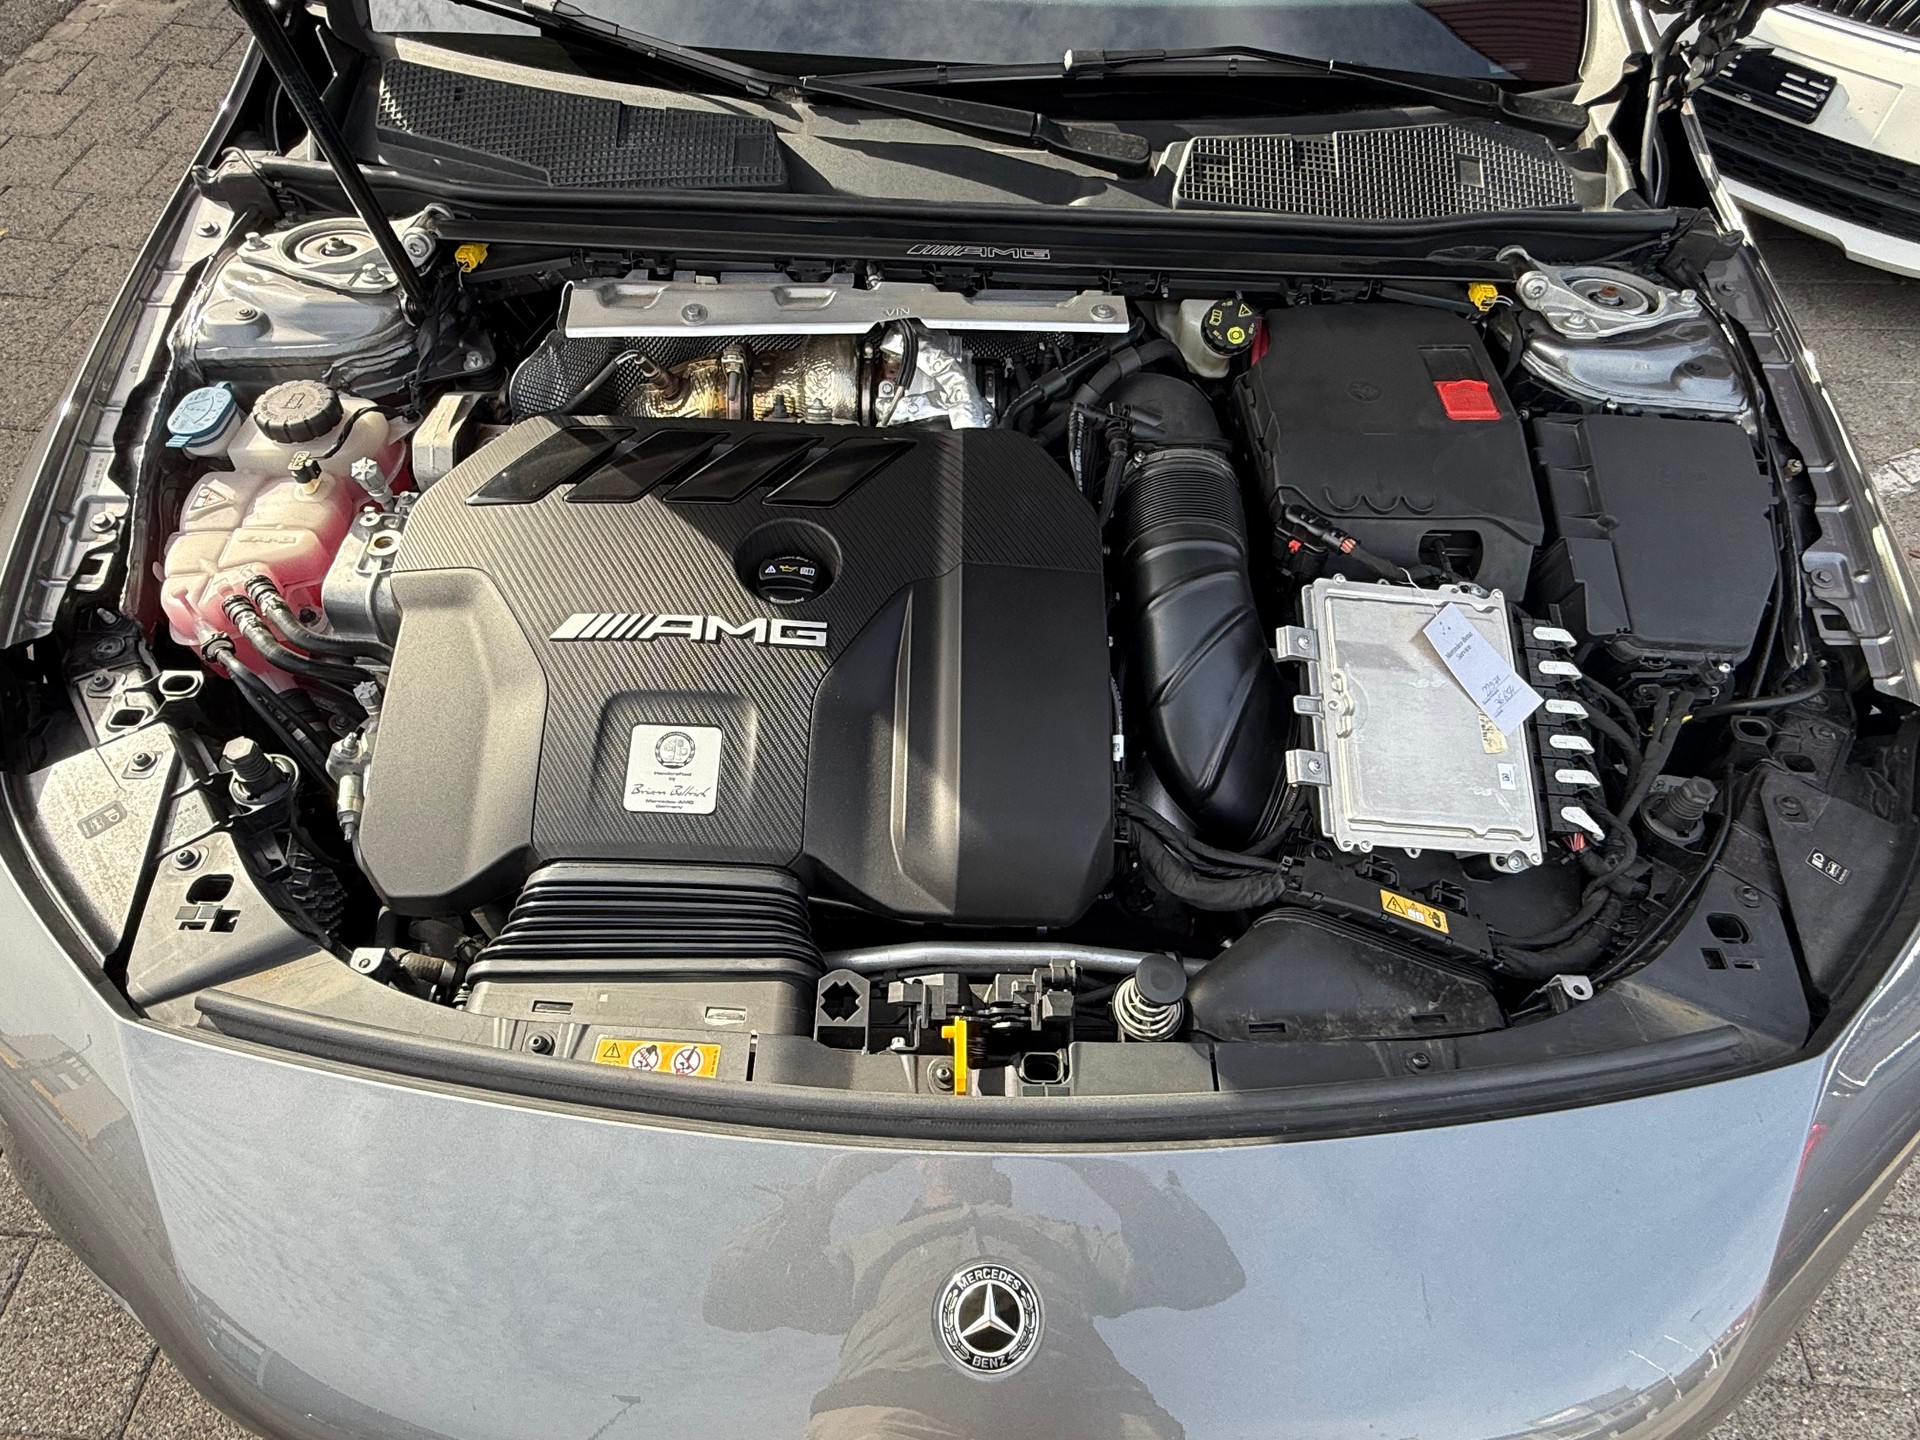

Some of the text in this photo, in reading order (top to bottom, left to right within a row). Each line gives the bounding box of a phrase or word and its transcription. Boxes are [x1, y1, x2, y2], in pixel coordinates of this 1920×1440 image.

[885, 307, 910, 317] VIN
[637, 614, 828, 647] AMG
[956, 1268, 1022, 1291] MERCEDES
[972, 1355, 1008, 1369] BENZ
